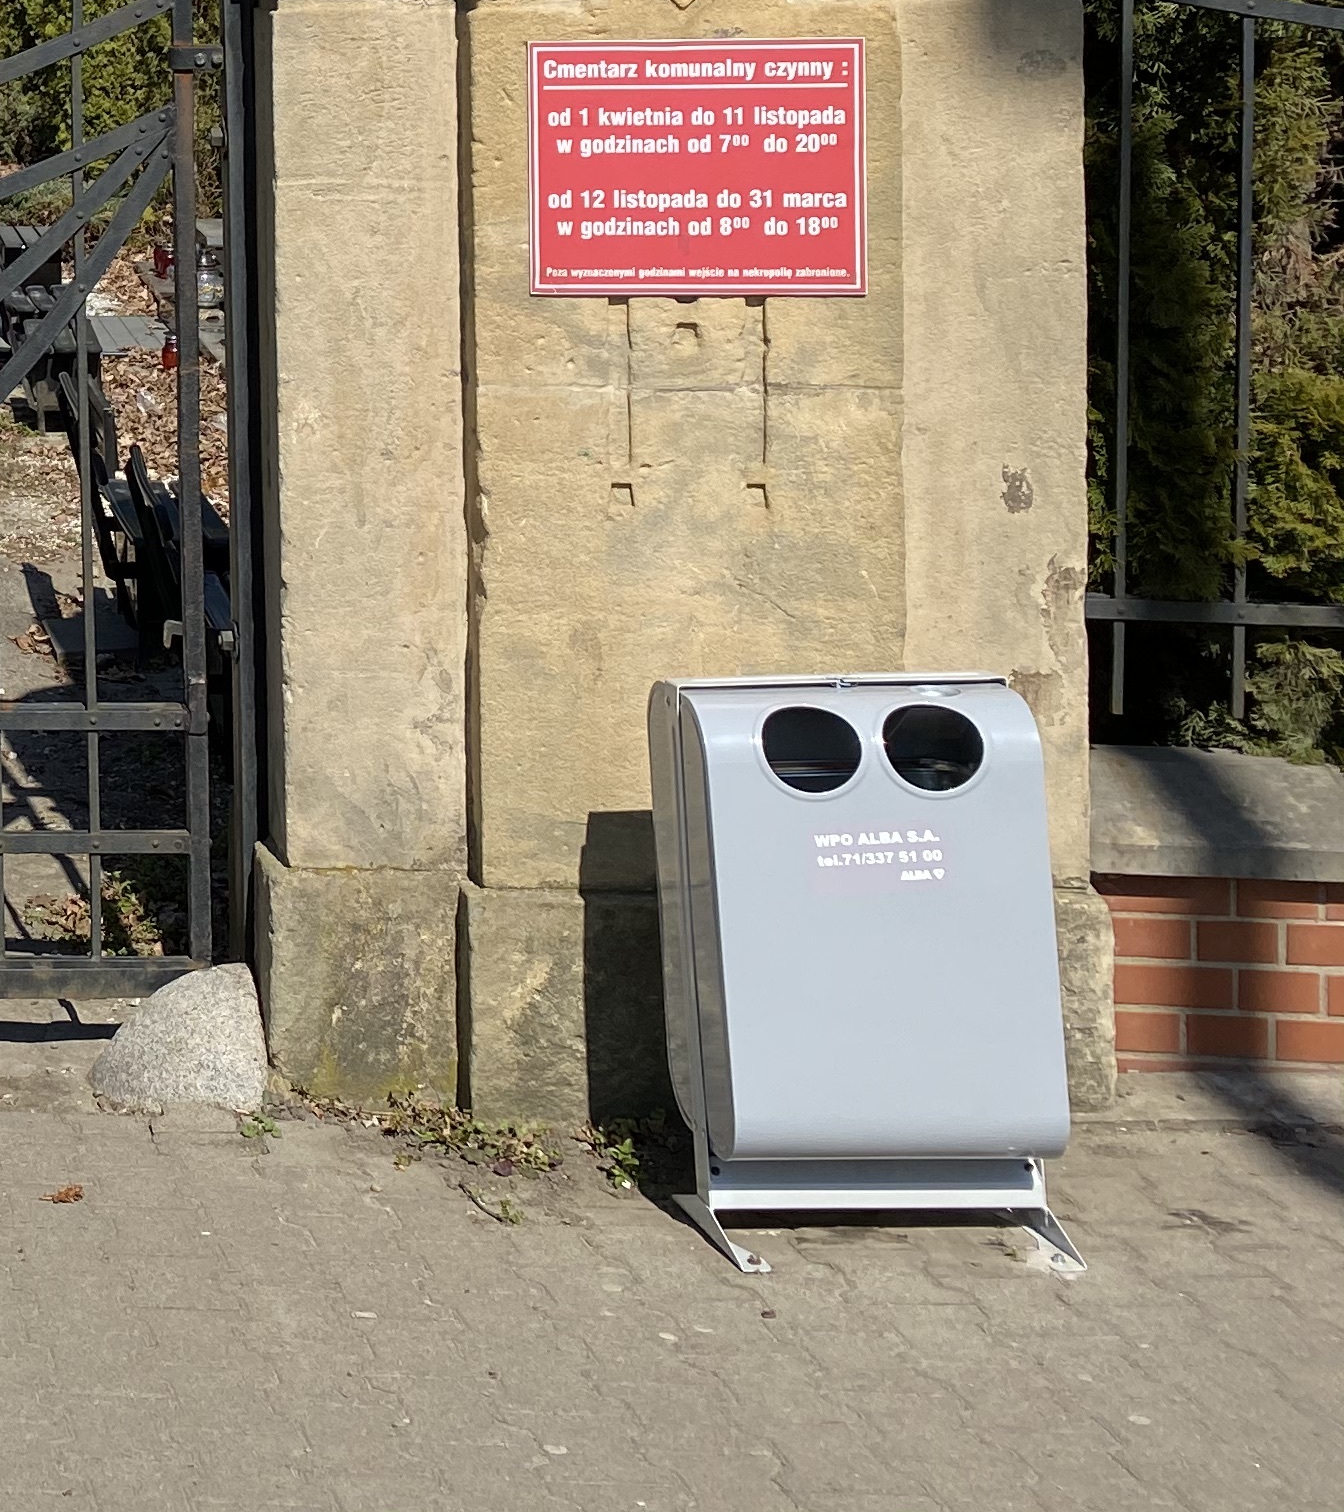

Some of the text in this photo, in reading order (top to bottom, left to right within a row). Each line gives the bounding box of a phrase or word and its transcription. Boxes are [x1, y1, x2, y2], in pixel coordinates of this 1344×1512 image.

[543, 60, 638, 79] Cmentarz
[645, 59, 756, 81] komunalny
[764, 60, 834, 80] czynny
[547, 106, 846, 129] od 1 kwietnia do 11 listopada
[556, 138, 573, 154] w
[580, 135, 680, 157] godzinach
[687, 134, 711, 153] od
[763, 134, 787, 153] do
[547, 189, 847, 212] od 12 listopada do 31 marca
[556, 220, 573, 236] w
[580, 217, 680, 240] godzinach
[687, 217, 712, 236] od
[763, 217, 787, 236] do
[546, 267, 568, 278] Poza
[571, 267, 636, 279] wyznaczonymi
[638, 267, 686, 279] godzinami
[689, 266, 725, 279] wejście
[727, 268, 740, 278] na
[813, 829, 940, 848] WPO ALBA S.A.
[816, 849, 943, 867] tel.71/337 51 00
[900, 869, 933, 881] ALBA
